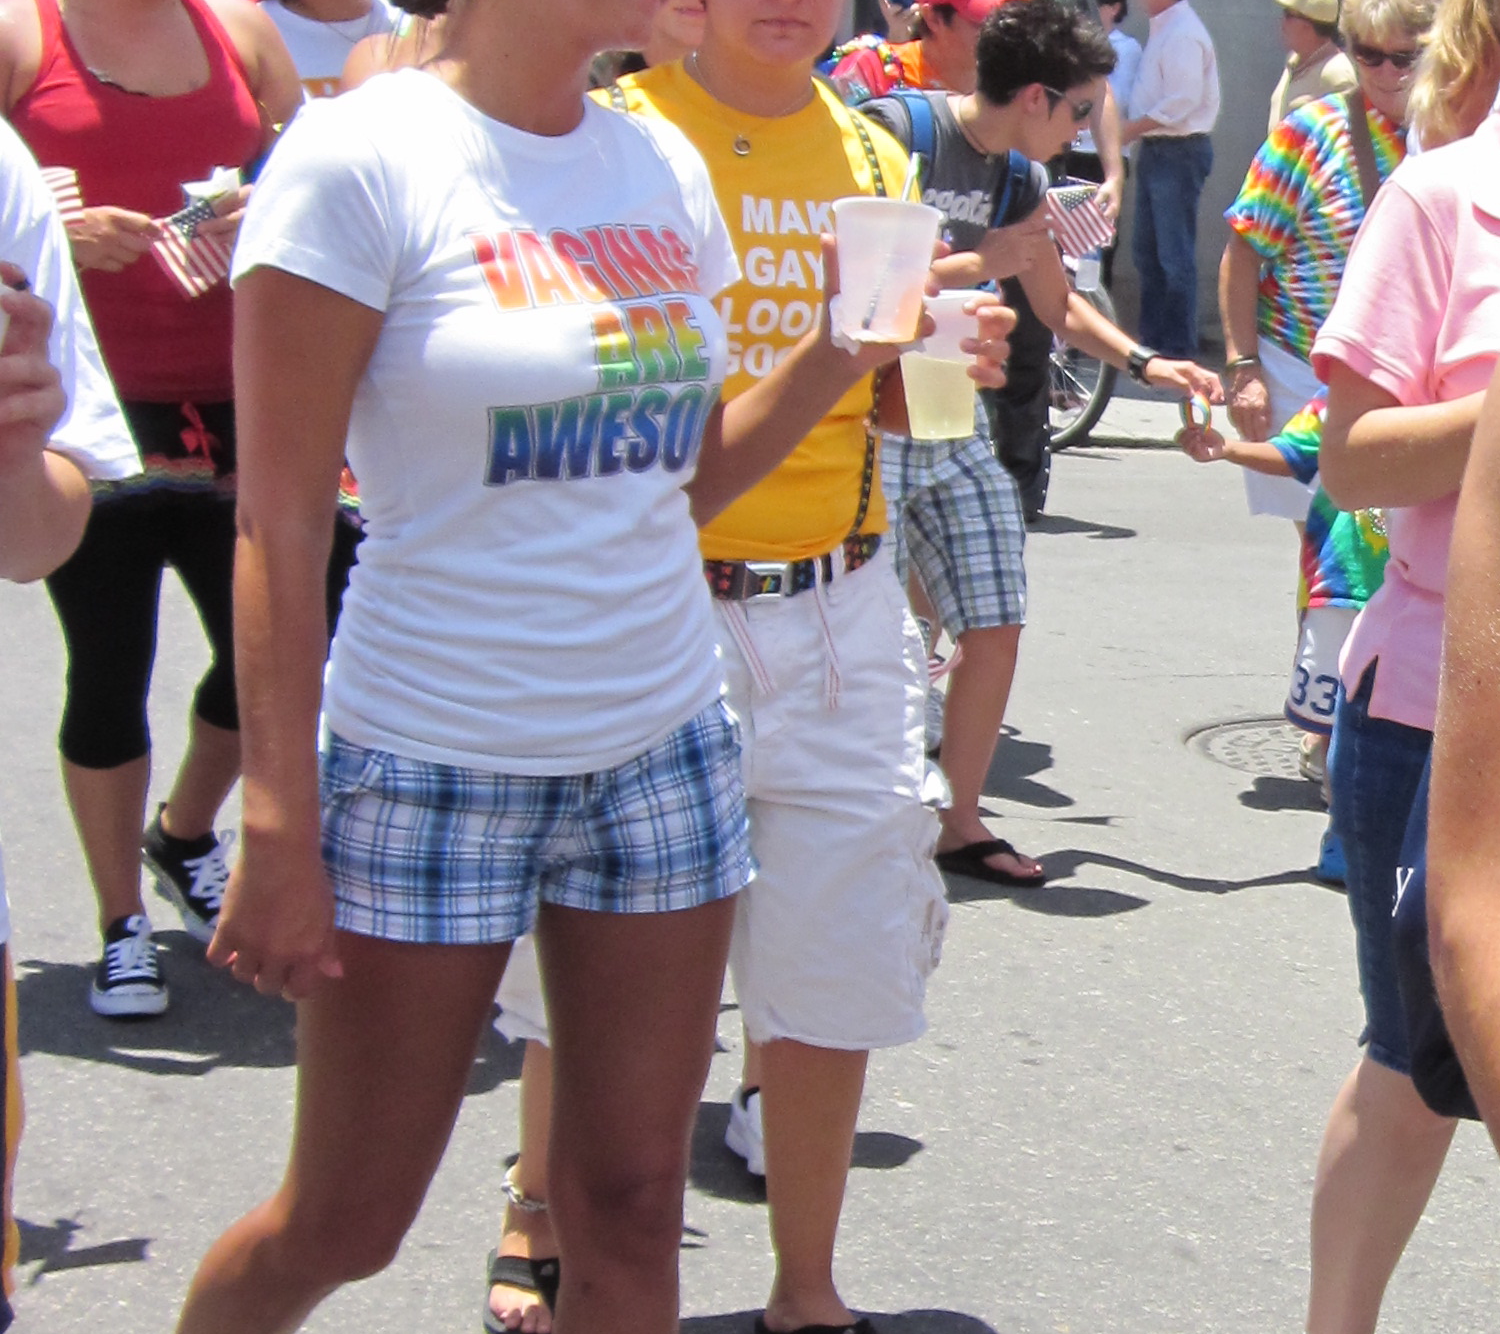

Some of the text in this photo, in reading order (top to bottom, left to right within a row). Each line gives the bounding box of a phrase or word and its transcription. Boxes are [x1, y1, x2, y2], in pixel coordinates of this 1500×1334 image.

[466, 223, 700, 313] VAGINAS
[745, 246, 825, 292] GAY
[590, 297, 711, 393] ARE
[484, 384, 722, 487] AWESO
[1292, 664, 1339, 716] 33
